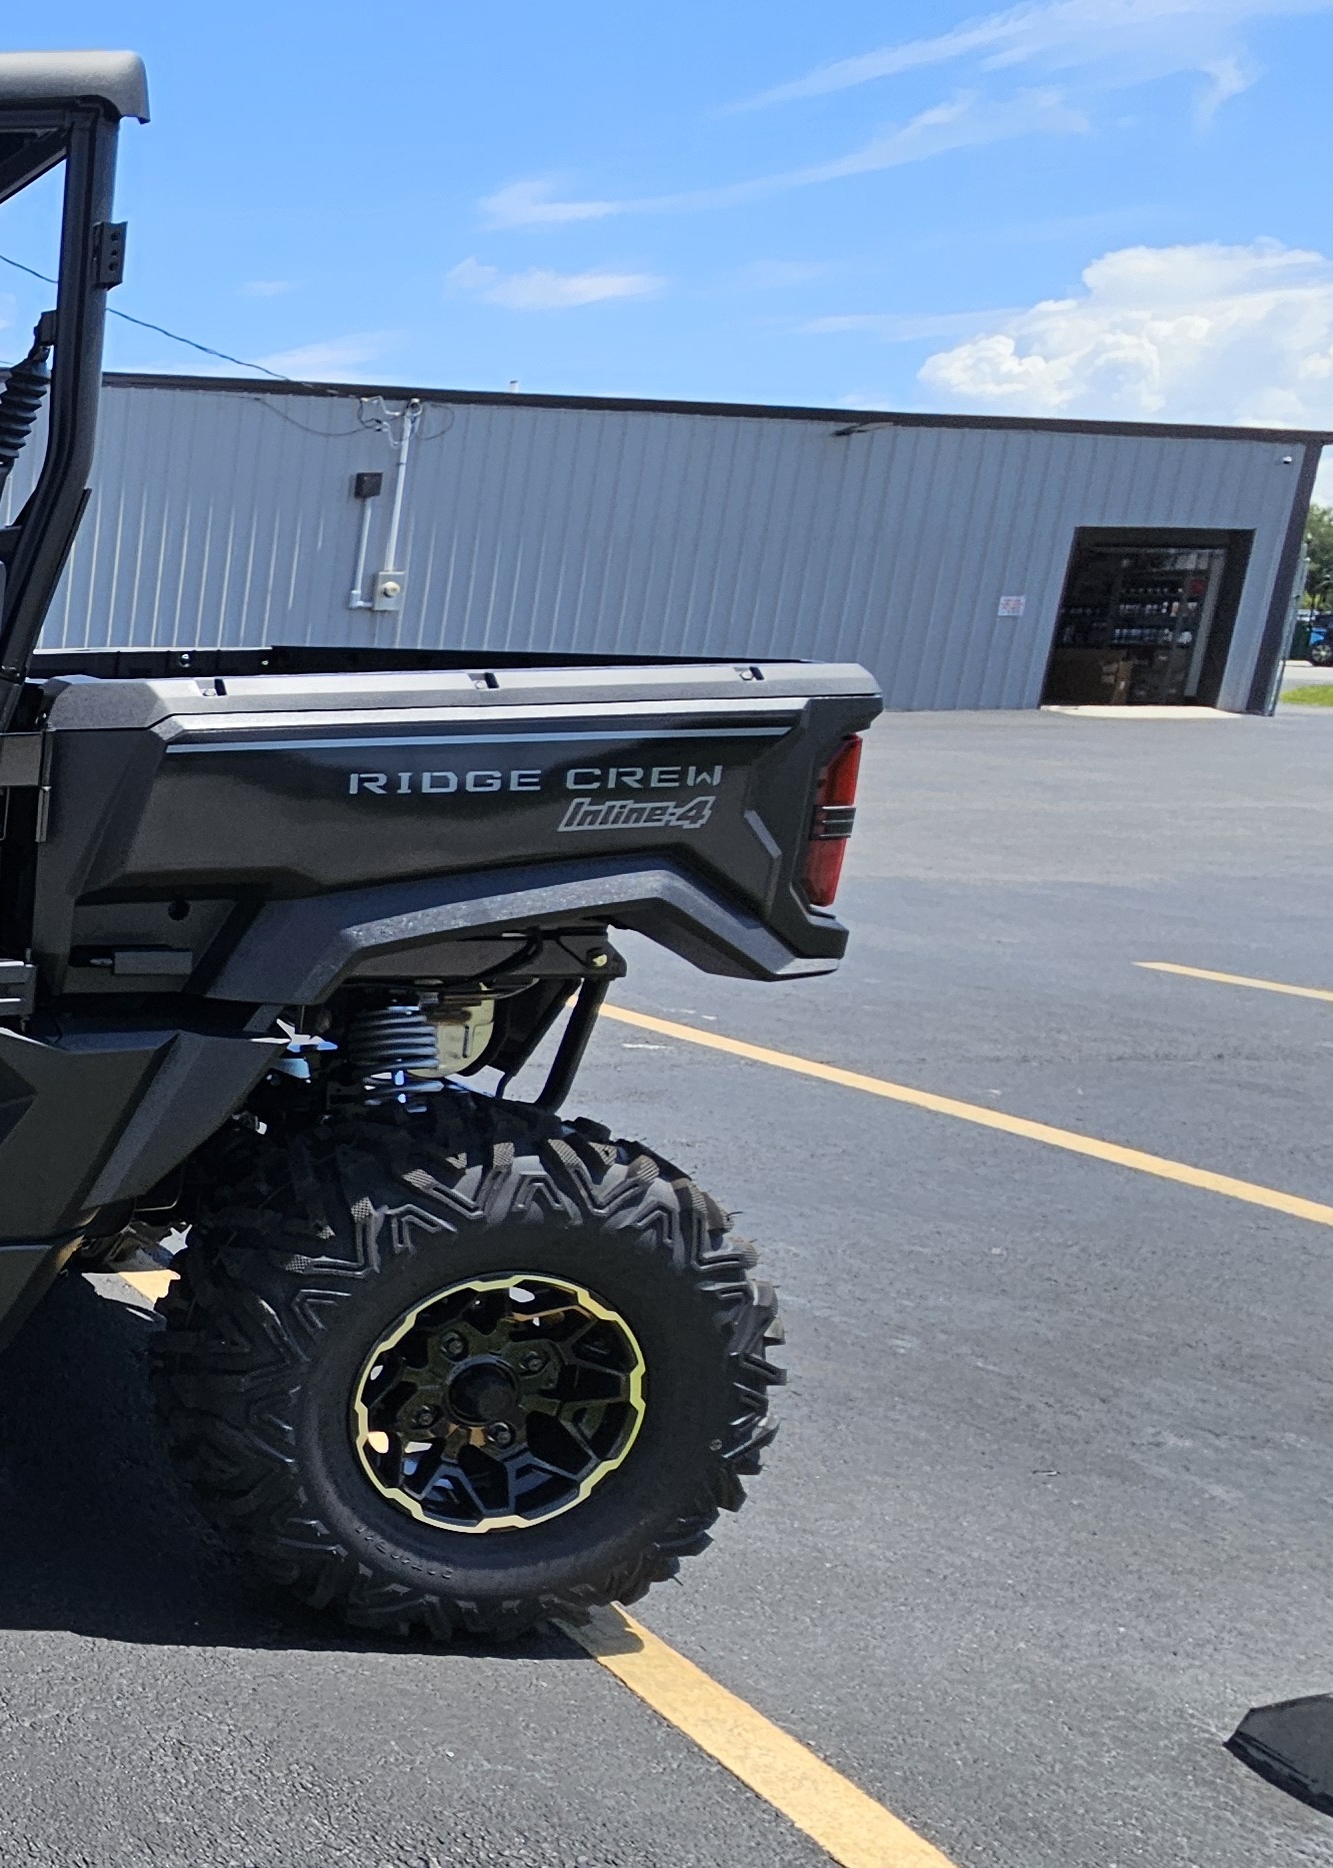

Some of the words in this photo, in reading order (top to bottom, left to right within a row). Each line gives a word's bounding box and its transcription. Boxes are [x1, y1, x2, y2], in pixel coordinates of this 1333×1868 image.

[349, 770, 542, 795] RIDGE
[565, 765, 723, 791] CREW
[557, 796, 717, 833] Inline-4
